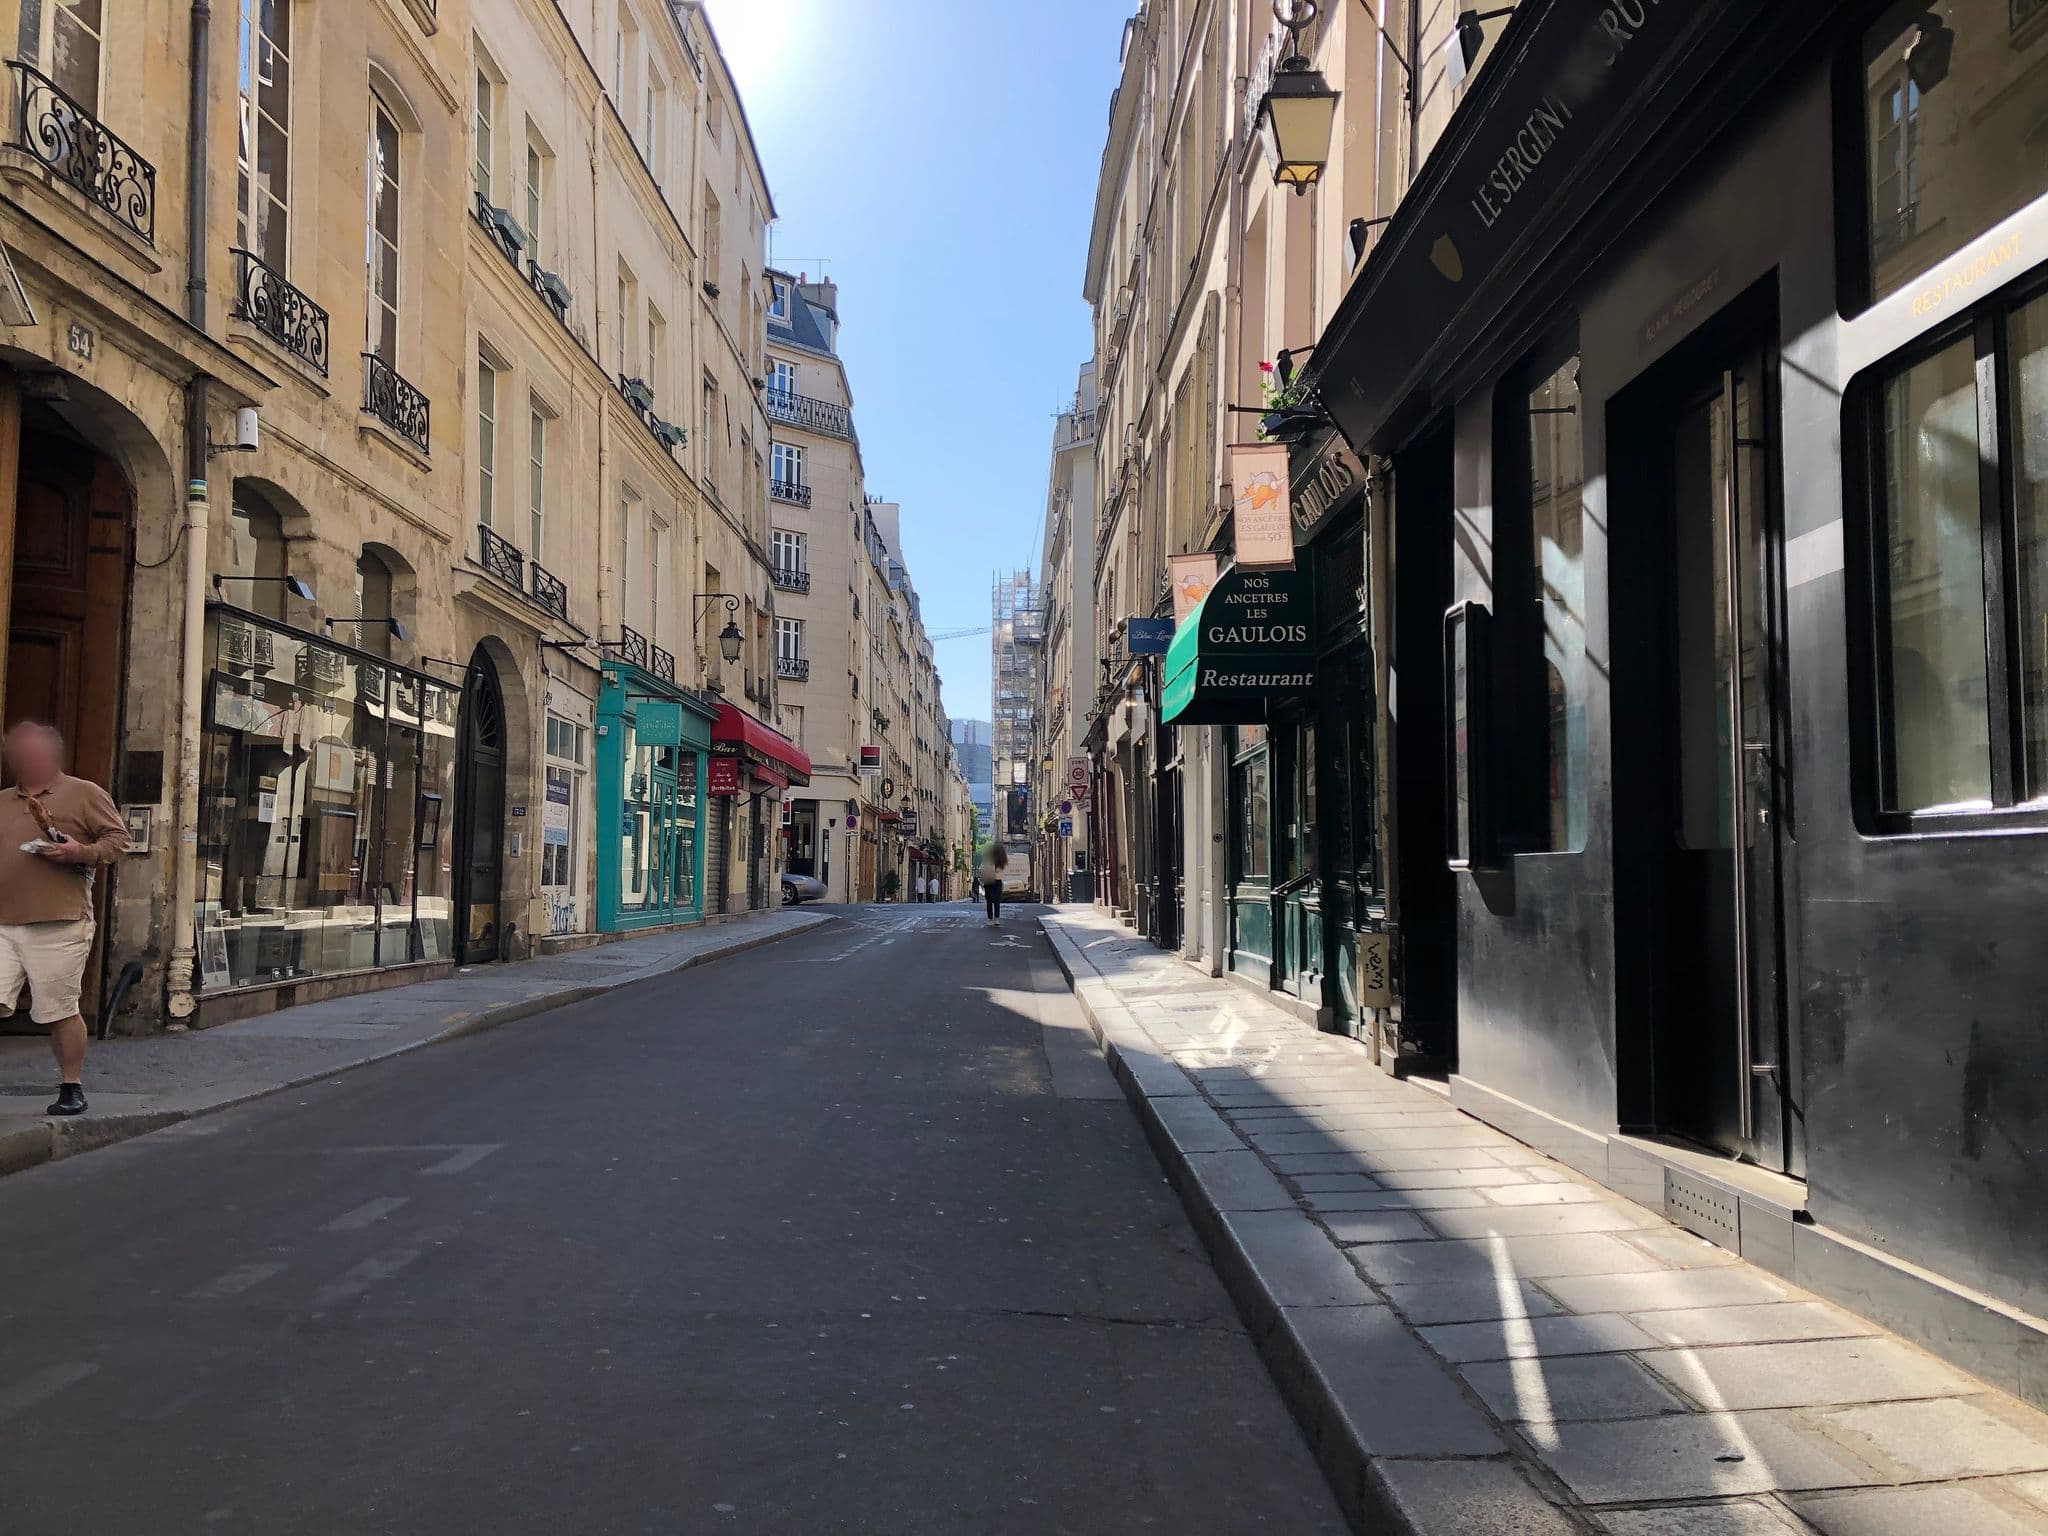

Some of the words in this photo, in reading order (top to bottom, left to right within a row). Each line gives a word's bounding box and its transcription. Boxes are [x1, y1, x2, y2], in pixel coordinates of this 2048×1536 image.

[1471, 184, 1502, 229] LE
[1911, 231, 2022, 318] RESTAURANT
[71, 325, 91, 357] 54
[1291, 451, 1353, 531] GAULOIS
[1267, 533, 1282, 543] 50
[1244, 578, 1269, 589] NOS
[1225, 593, 1288, 604] ANCETRES
[1246, 609, 1267, 619] LES
[1209, 625, 1307, 643] GAULOIS
[1202, 669, 1313, 687] Restaurant
[712, 742, 737, 753] Bar
